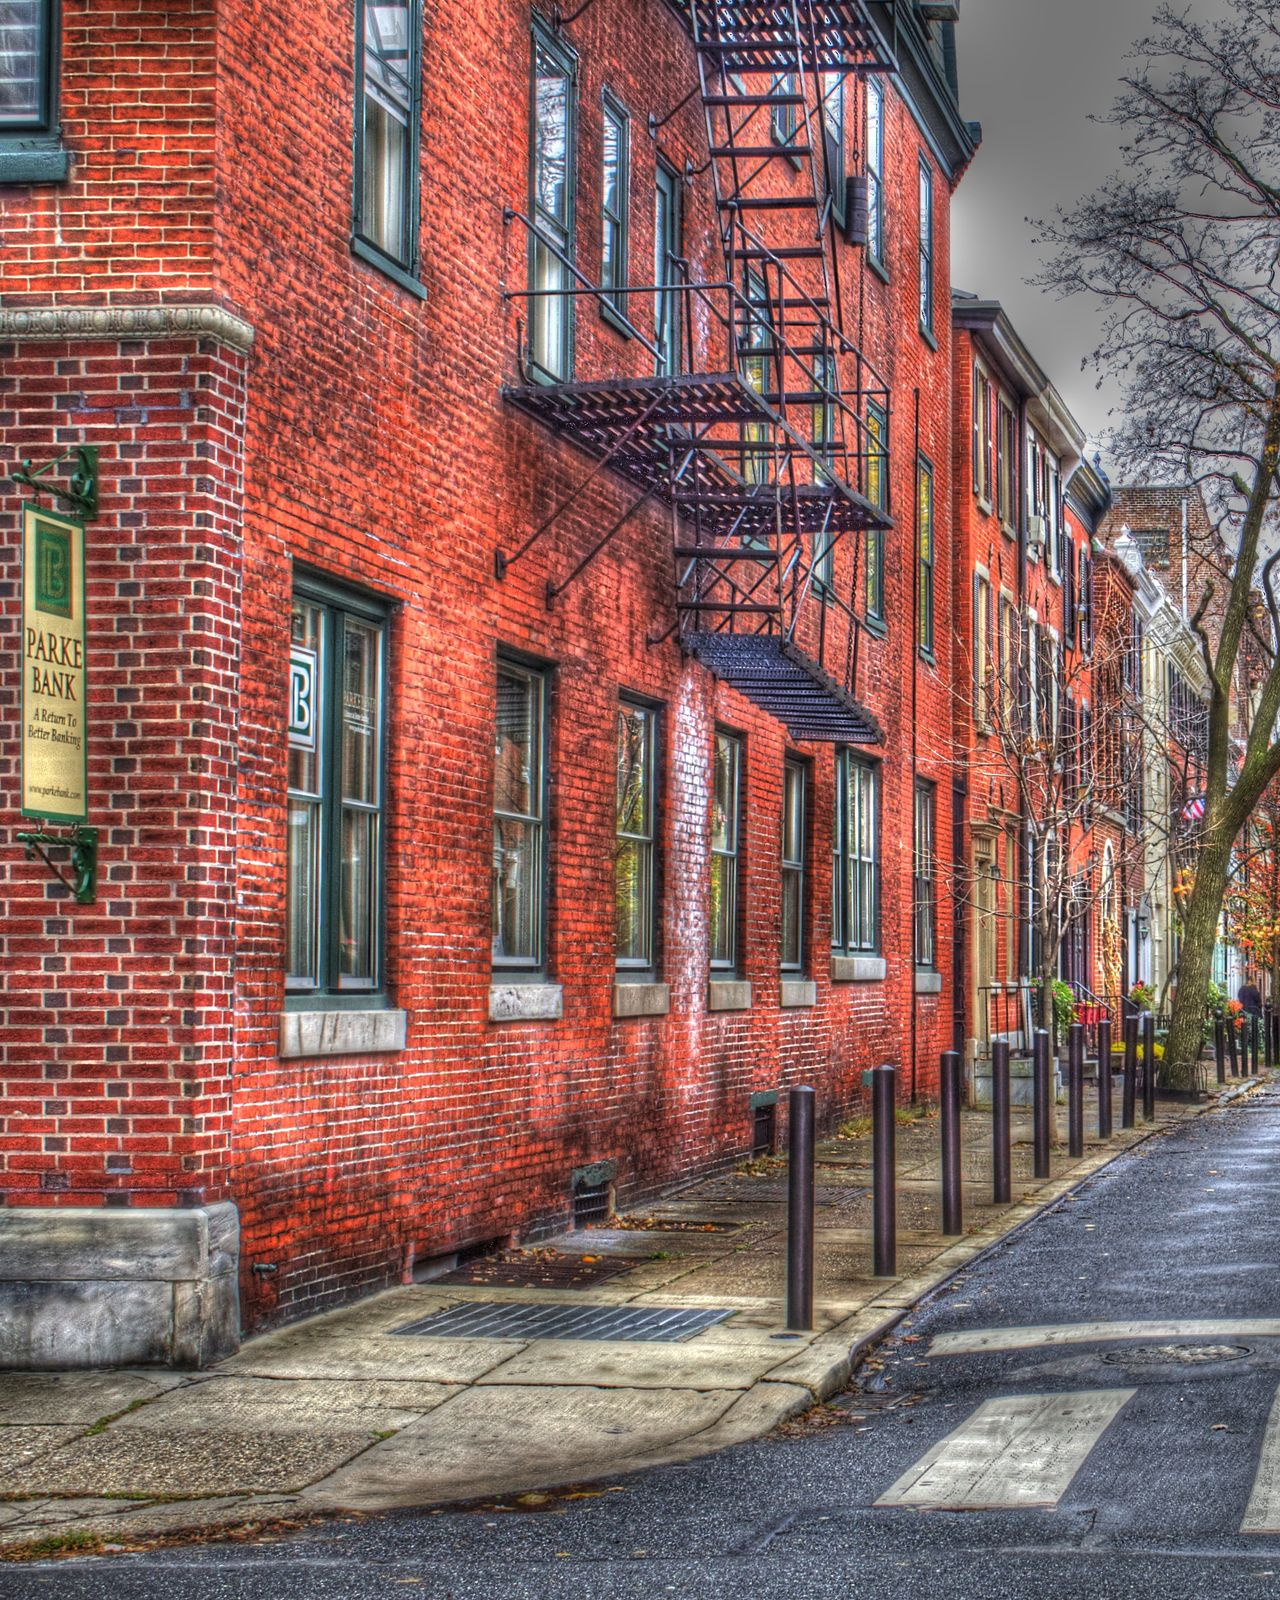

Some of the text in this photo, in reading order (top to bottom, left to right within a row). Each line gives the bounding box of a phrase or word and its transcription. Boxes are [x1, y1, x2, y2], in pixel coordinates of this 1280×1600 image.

[26, 626, 82, 670] PARKE
[32, 666, 77, 701] BANK
[34, 706, 78, 728] A Return To
[28, 724, 81, 751] Better Banking
